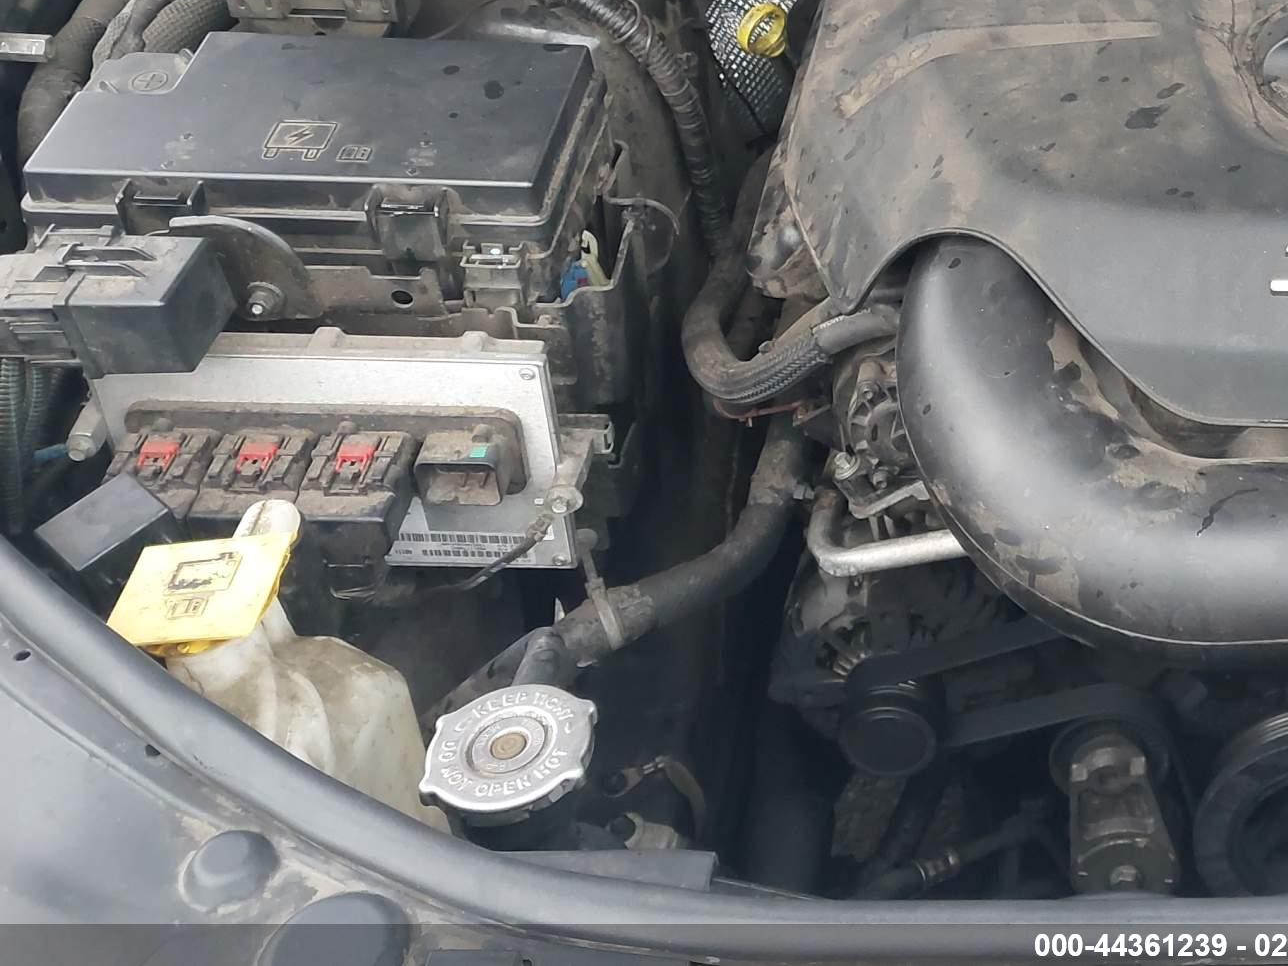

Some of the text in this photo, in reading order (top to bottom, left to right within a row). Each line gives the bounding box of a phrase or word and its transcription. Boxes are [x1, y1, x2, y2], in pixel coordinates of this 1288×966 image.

[472, 692, 528, 719] KEEP
[439, 740, 457, 762] DO
[533, 748, 568, 779] HOT
[441, 767, 473, 791] NOT
[474, 776, 531, 797] OPEN
